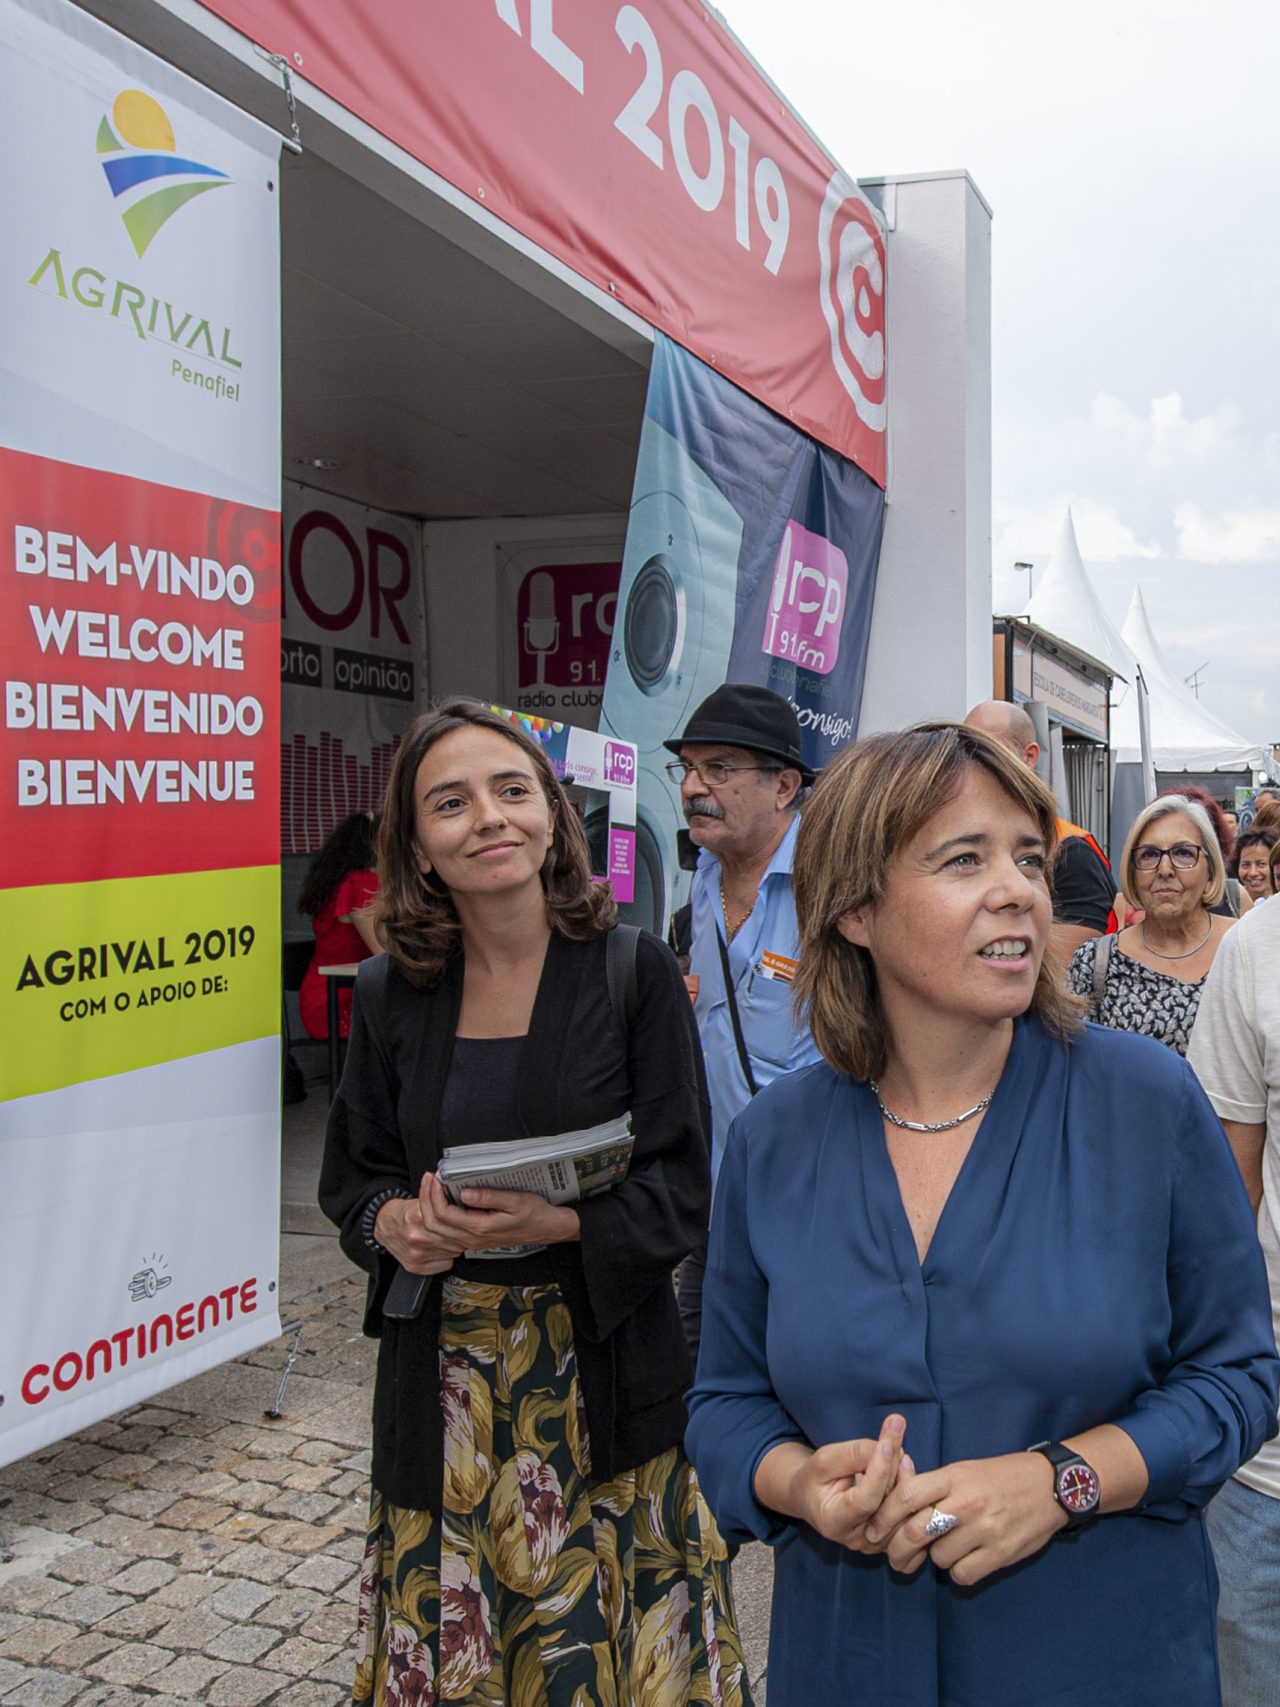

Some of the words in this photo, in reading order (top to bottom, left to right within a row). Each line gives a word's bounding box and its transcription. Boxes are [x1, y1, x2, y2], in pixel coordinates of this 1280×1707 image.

[614, 5, 790, 276] 2019
[27, 247, 243, 369] AGRIVAL
[171, 358, 240, 402] Penafiel
[15, 524, 255, 606] BEM-VINDO
[283, 509, 412, 646] OR
[787, 559, 842, 637] rcp
[28, 604, 245, 671] WELCOME
[571, 590, 613, 638] rc
[6, 680, 264, 737] BIENVENIDO
[335, 659, 411, 692] opinião
[18, 758, 255, 807] BIENVENUE
[613, 752, 634, 775] rcp
[15, 936, 175, 992] AGRIVAL
[184, 924, 256, 966] 2019
[59, 995, 107, 1022] COM
[114, 992, 131, 1012] O
[136, 979, 196, 1009] APOIO
[202, 975, 229, 996] DE:
[21, 1277, 257, 1405] CONTINENTE
